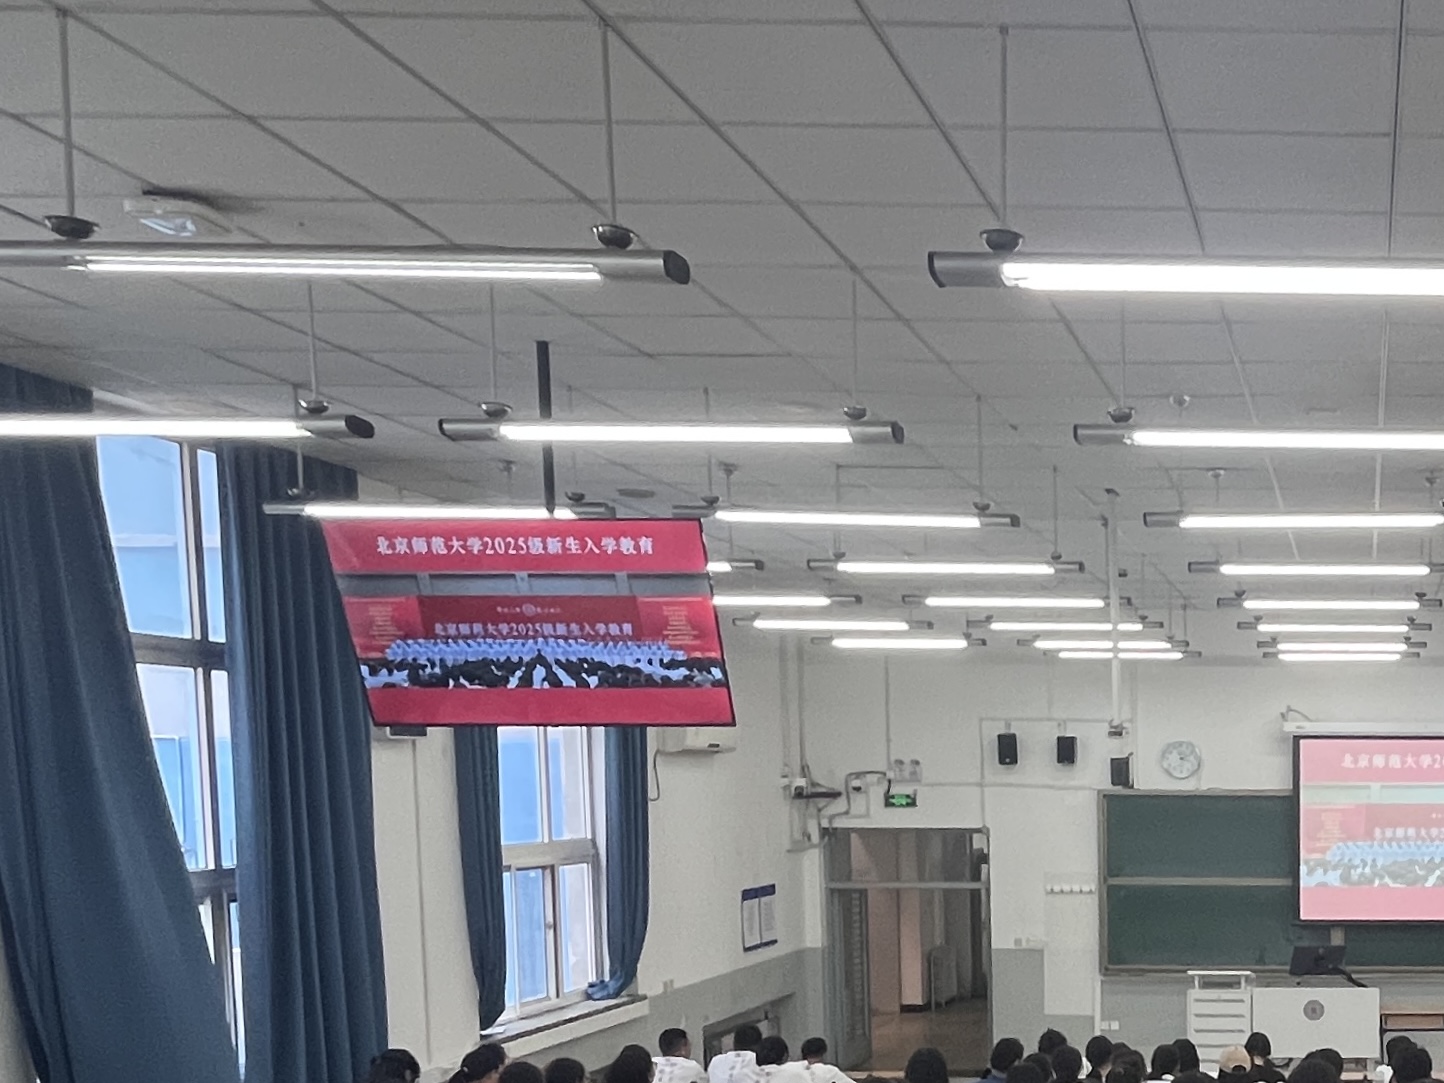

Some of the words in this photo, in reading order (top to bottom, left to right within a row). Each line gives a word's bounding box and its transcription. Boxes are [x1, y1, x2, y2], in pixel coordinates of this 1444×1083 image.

[376, 536, 653, 555] 北京师范大学2025级新生入学教育
